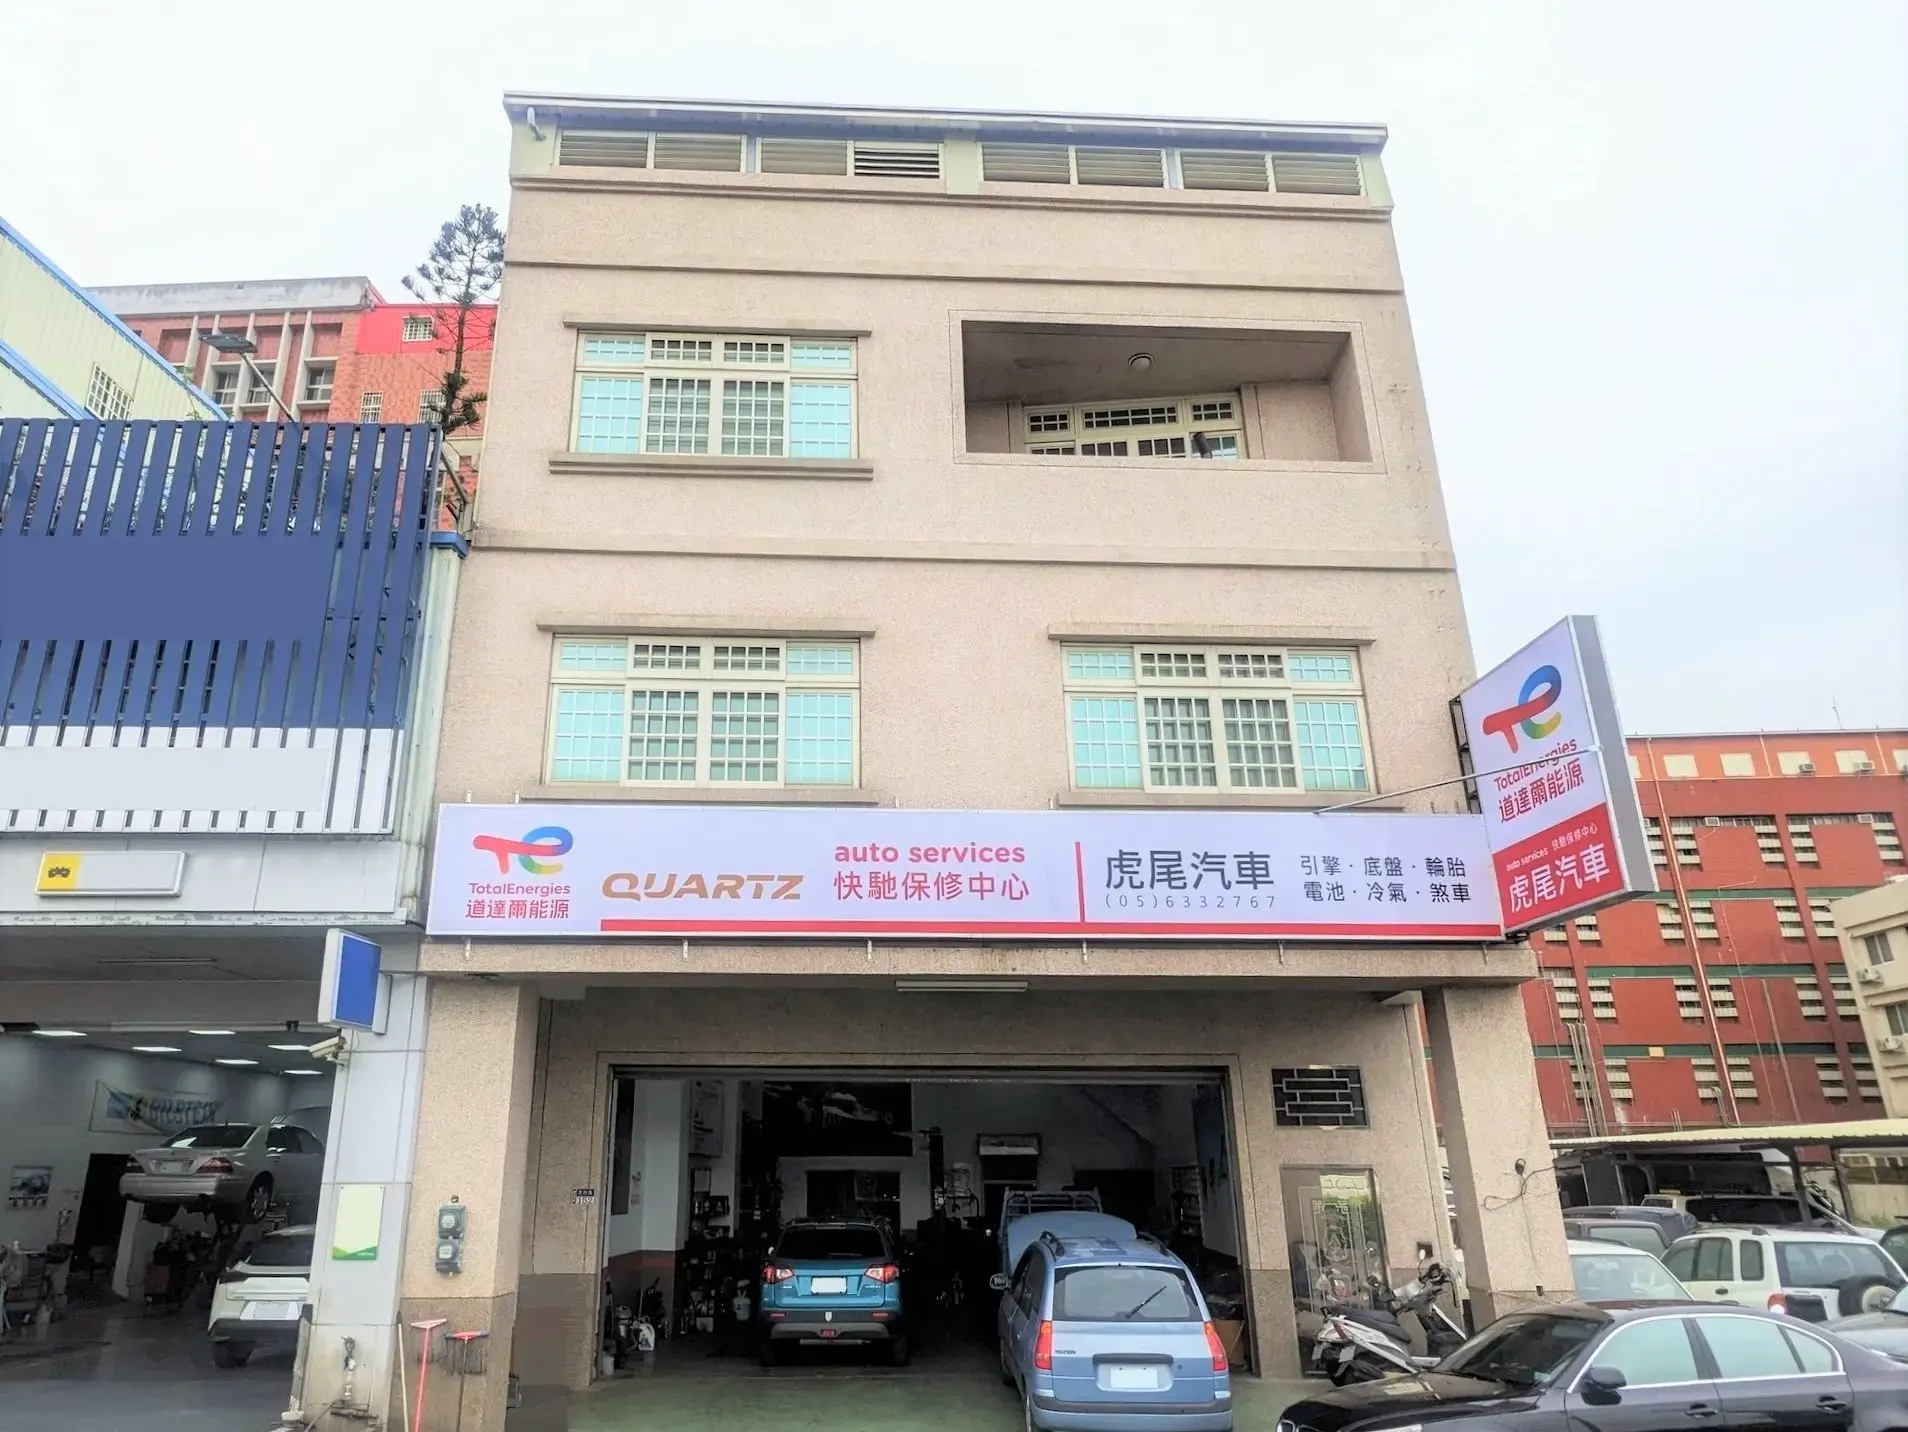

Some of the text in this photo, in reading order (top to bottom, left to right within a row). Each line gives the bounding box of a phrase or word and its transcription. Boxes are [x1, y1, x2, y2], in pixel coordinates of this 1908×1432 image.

[1494, 738, 1577, 792] TotalEnergies
[1498, 757, 1585, 824] 道達爾能源
[834, 842, 1026, 863] auto services
[1506, 847, 1549, 872] auto services
[1105, 850, 1275, 891] 虎尾汽車
[1509, 842, 1611, 914] 虎尾汽車
[469, 882, 571, 899] TotalEnergies
[602, 873, 804, 901] QUARTZ
[833, 871, 1030, 901] 快馳保修中心
[465, 899, 570, 919] 道達爾能源
[1105, 894, 1275, 909] (05)6332767
